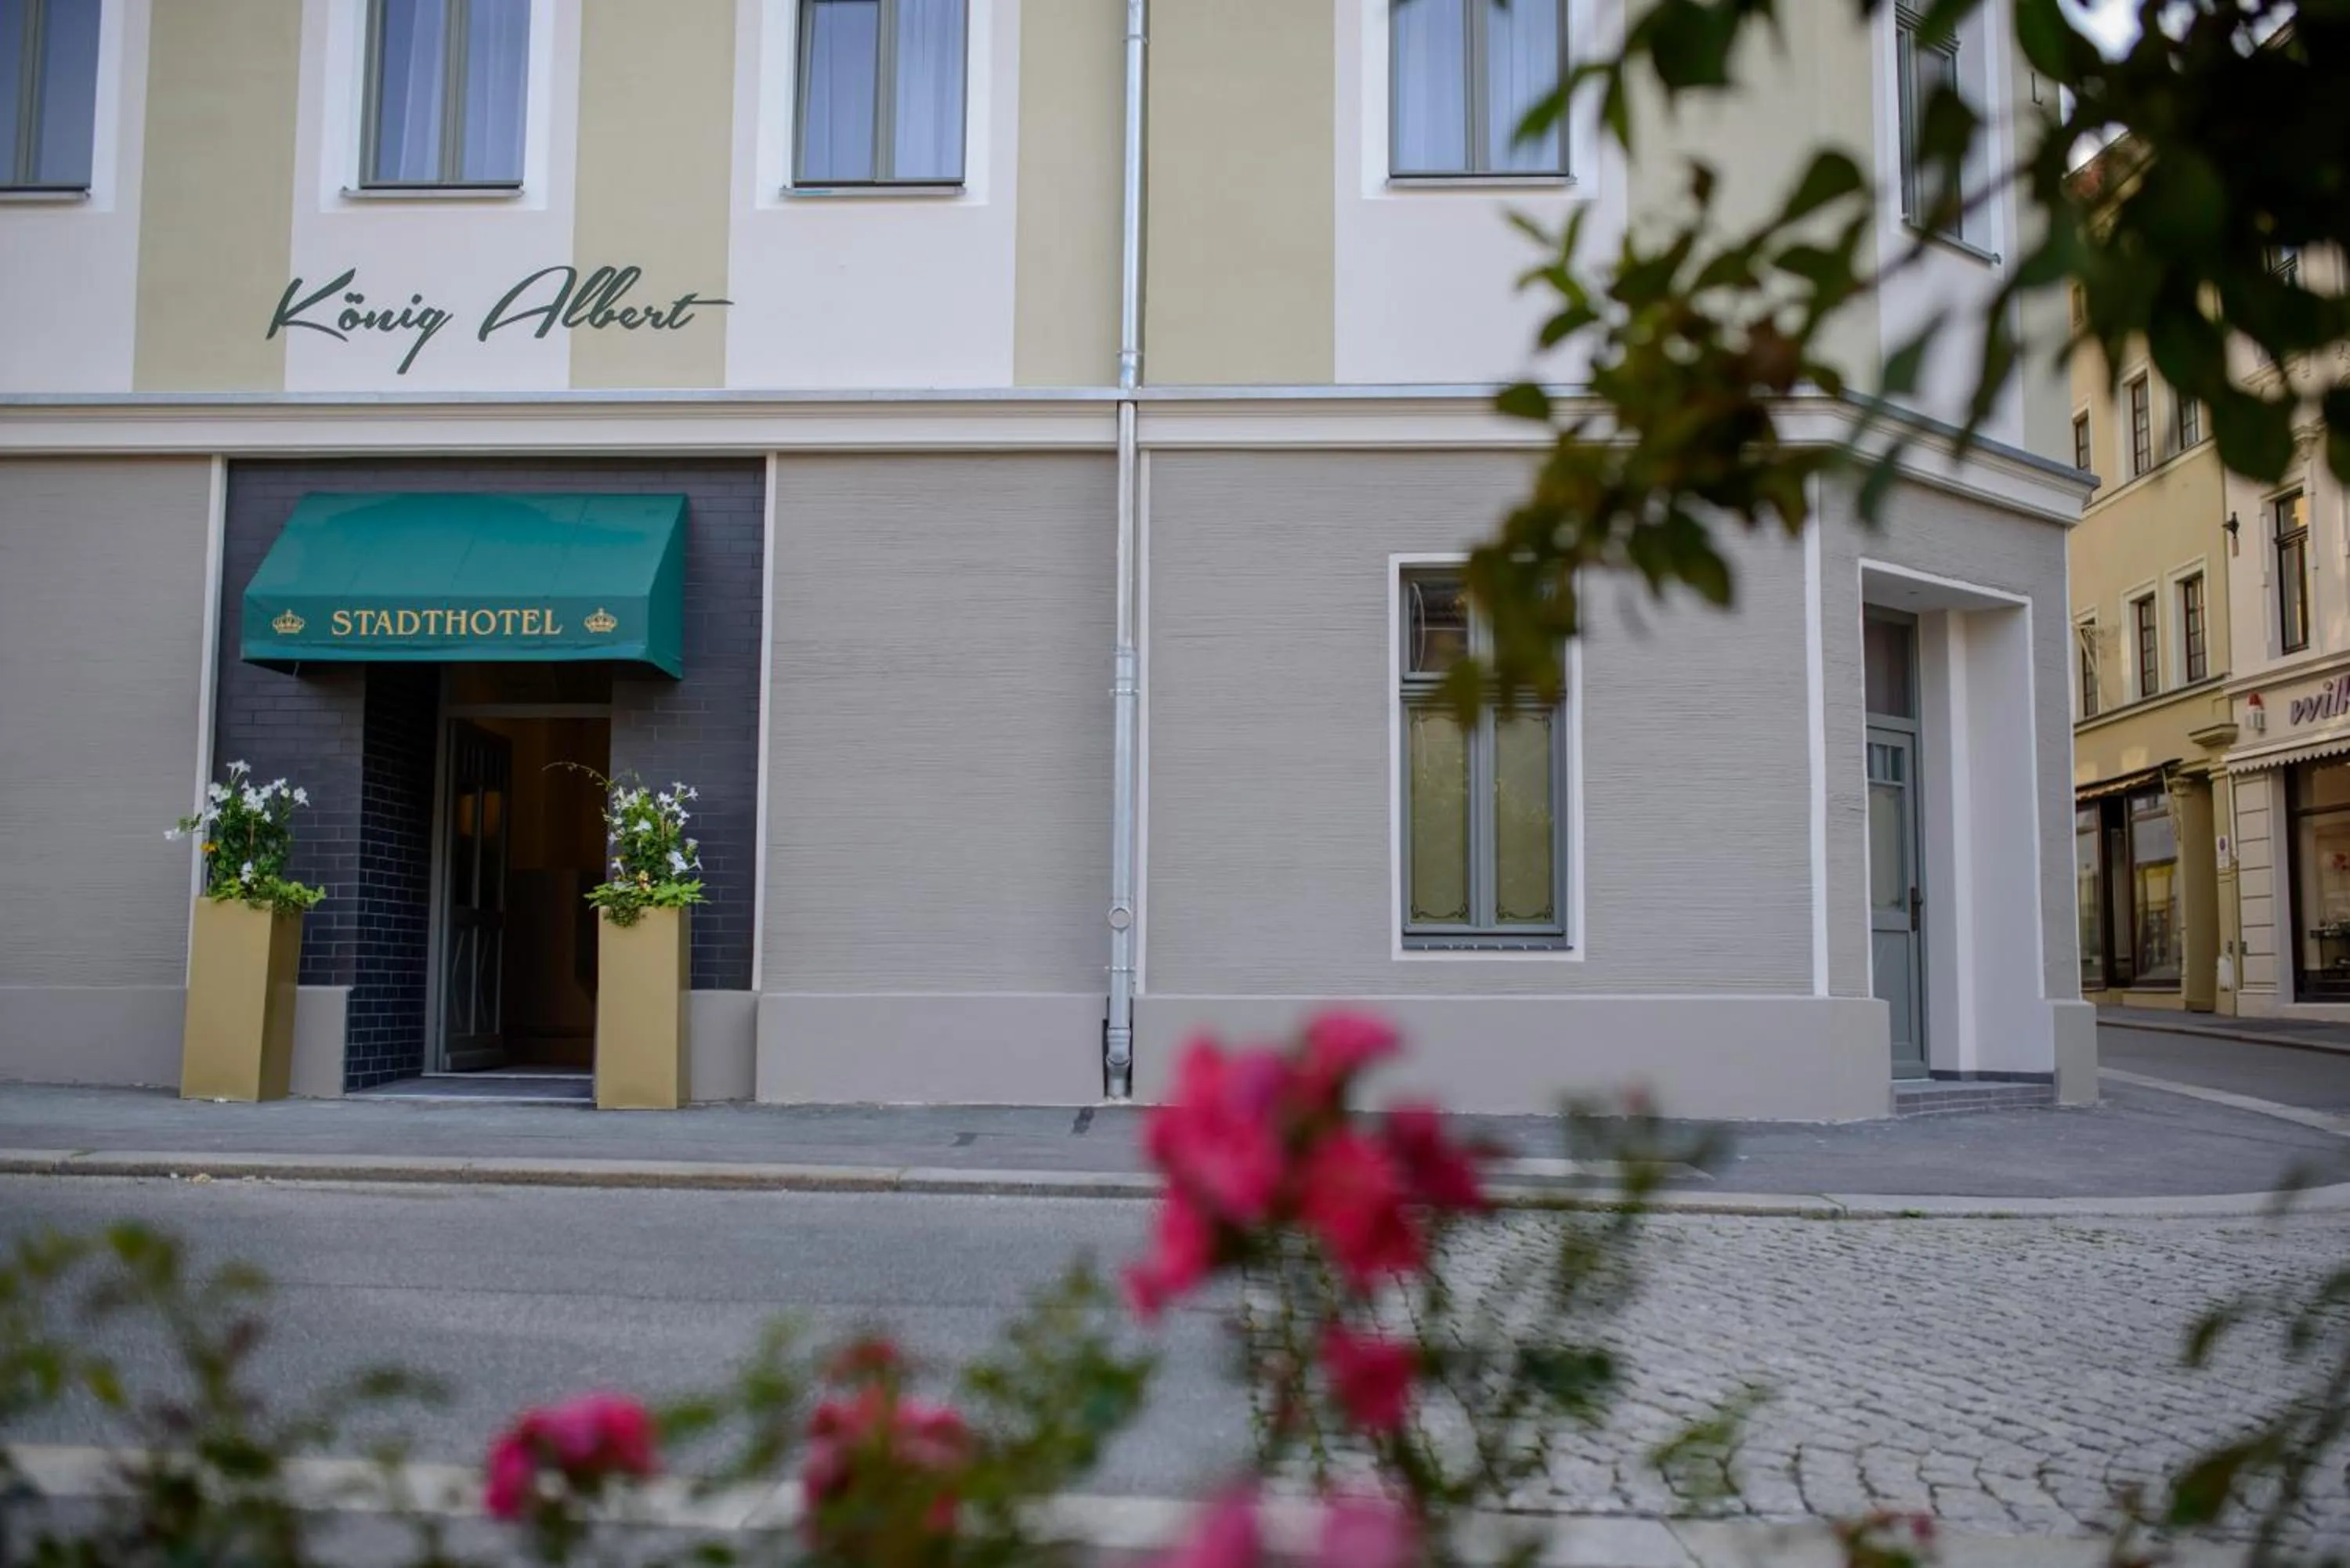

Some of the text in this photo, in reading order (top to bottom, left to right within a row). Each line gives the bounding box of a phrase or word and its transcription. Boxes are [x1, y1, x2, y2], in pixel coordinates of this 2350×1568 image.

[266, 266, 735, 374] König Albert
[331, 609, 562, 636] STADTHOTEL
